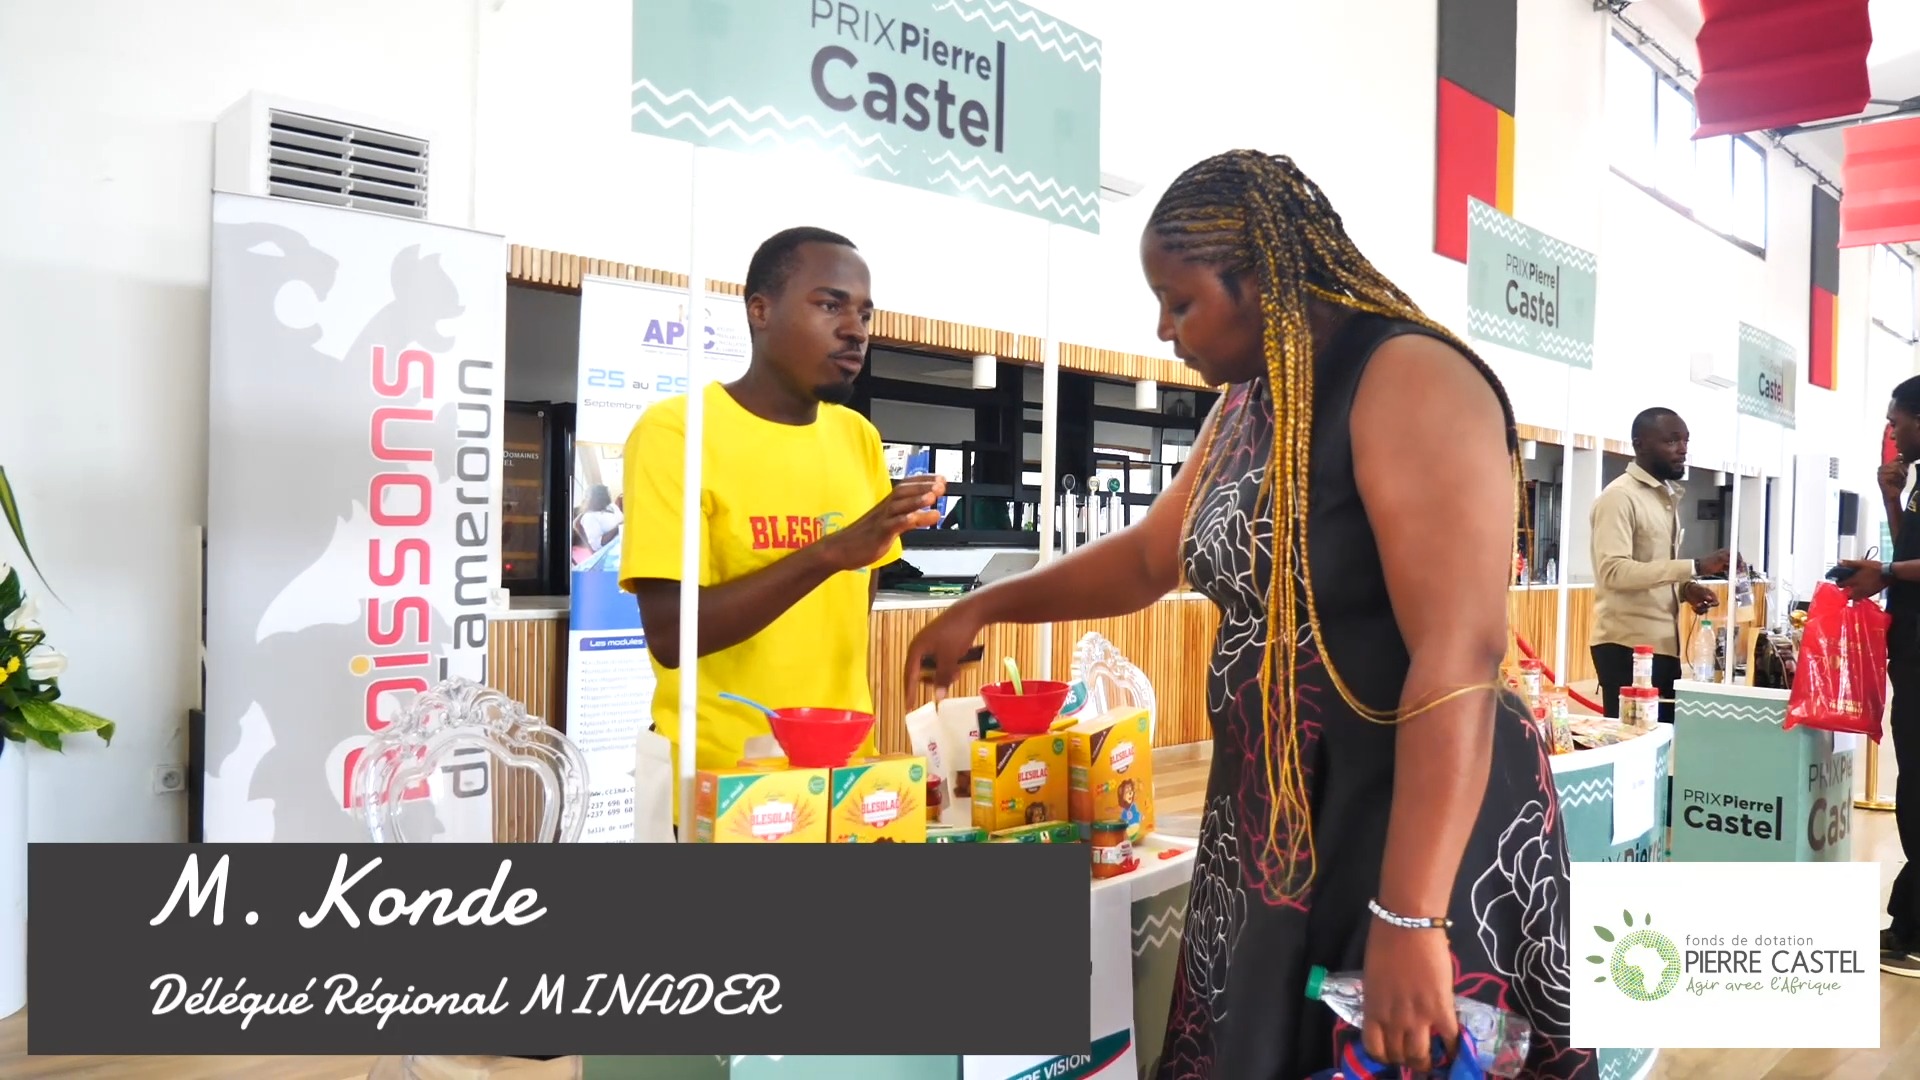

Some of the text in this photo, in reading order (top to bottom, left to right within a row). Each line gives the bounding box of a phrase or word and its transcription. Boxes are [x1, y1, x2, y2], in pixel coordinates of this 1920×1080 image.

[811, 41, 1006, 153] Castel
[1505, 265, 1560, 329] Castel
[643, 319, 716, 350] APC
[588, 367, 625, 389] 25
[632, 381, 649, 390] au
[584, 398, 642, 411] Septembre
[607, 637, 643, 647] modules
[1684, 796, 1783, 841] Castel
